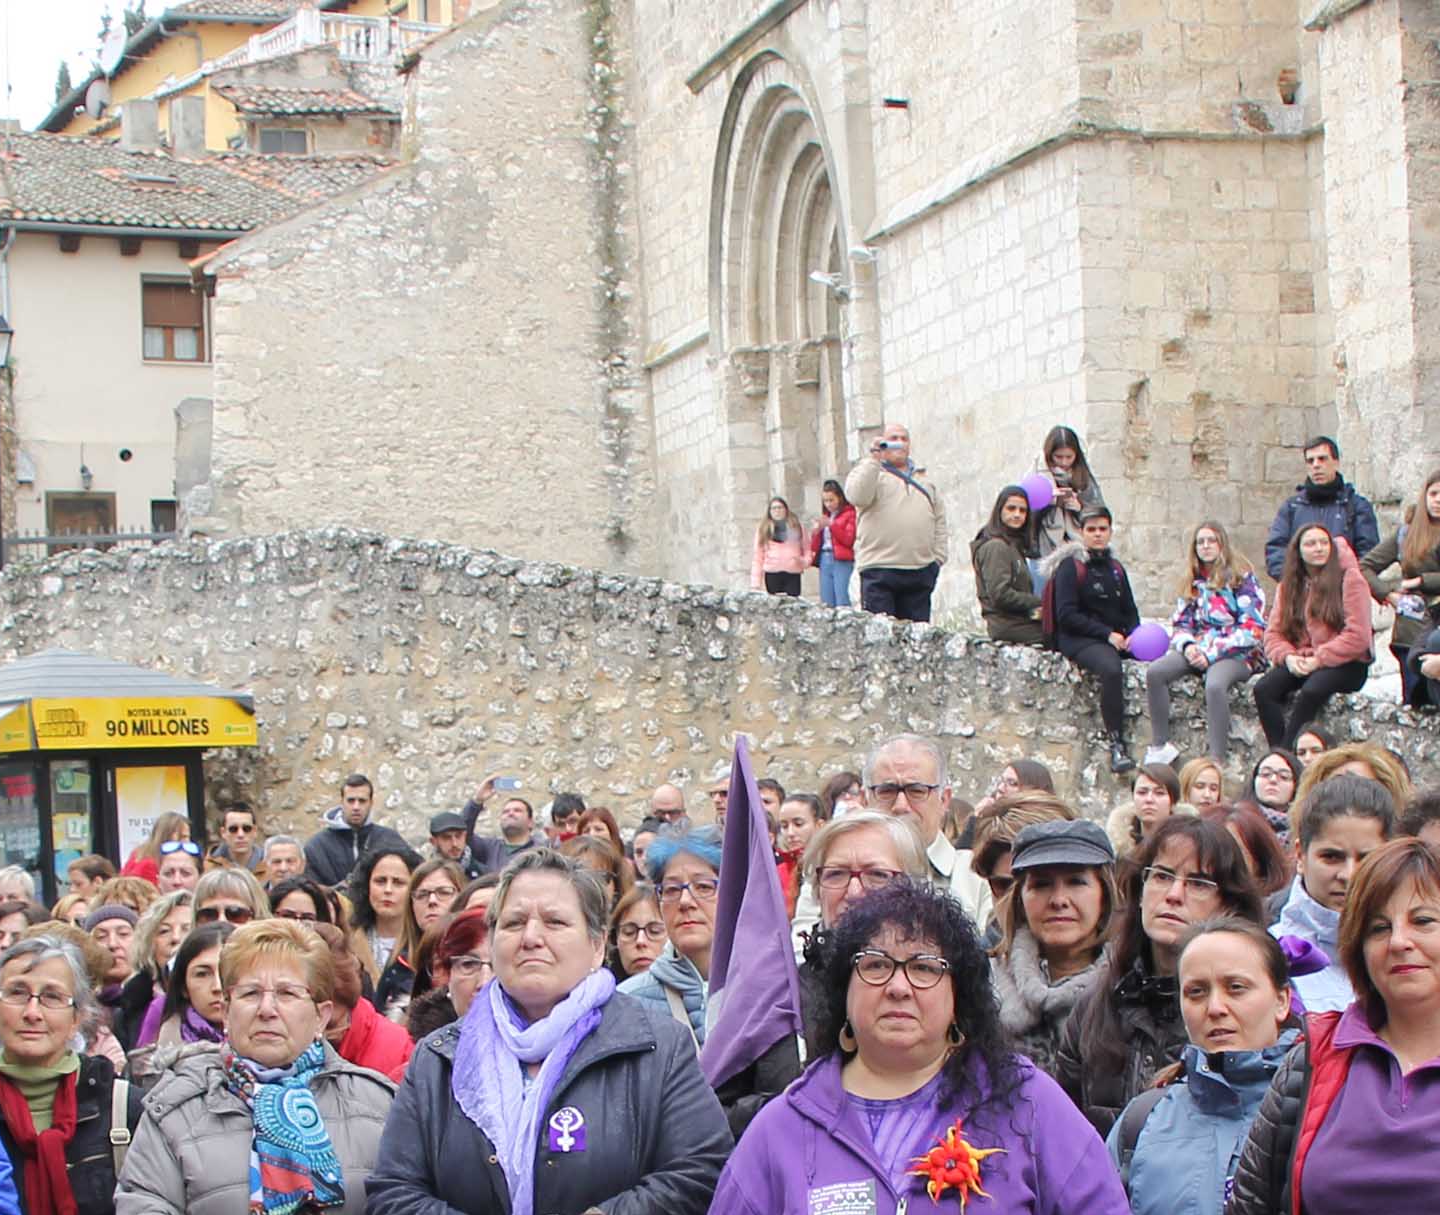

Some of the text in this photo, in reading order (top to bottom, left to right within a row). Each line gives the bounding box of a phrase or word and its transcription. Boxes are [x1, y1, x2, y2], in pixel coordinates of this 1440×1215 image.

[128, 707, 187, 717] BOTES DE HASTA
[105, 719, 128, 737] 90
[132, 718, 209, 737] MILLONES
